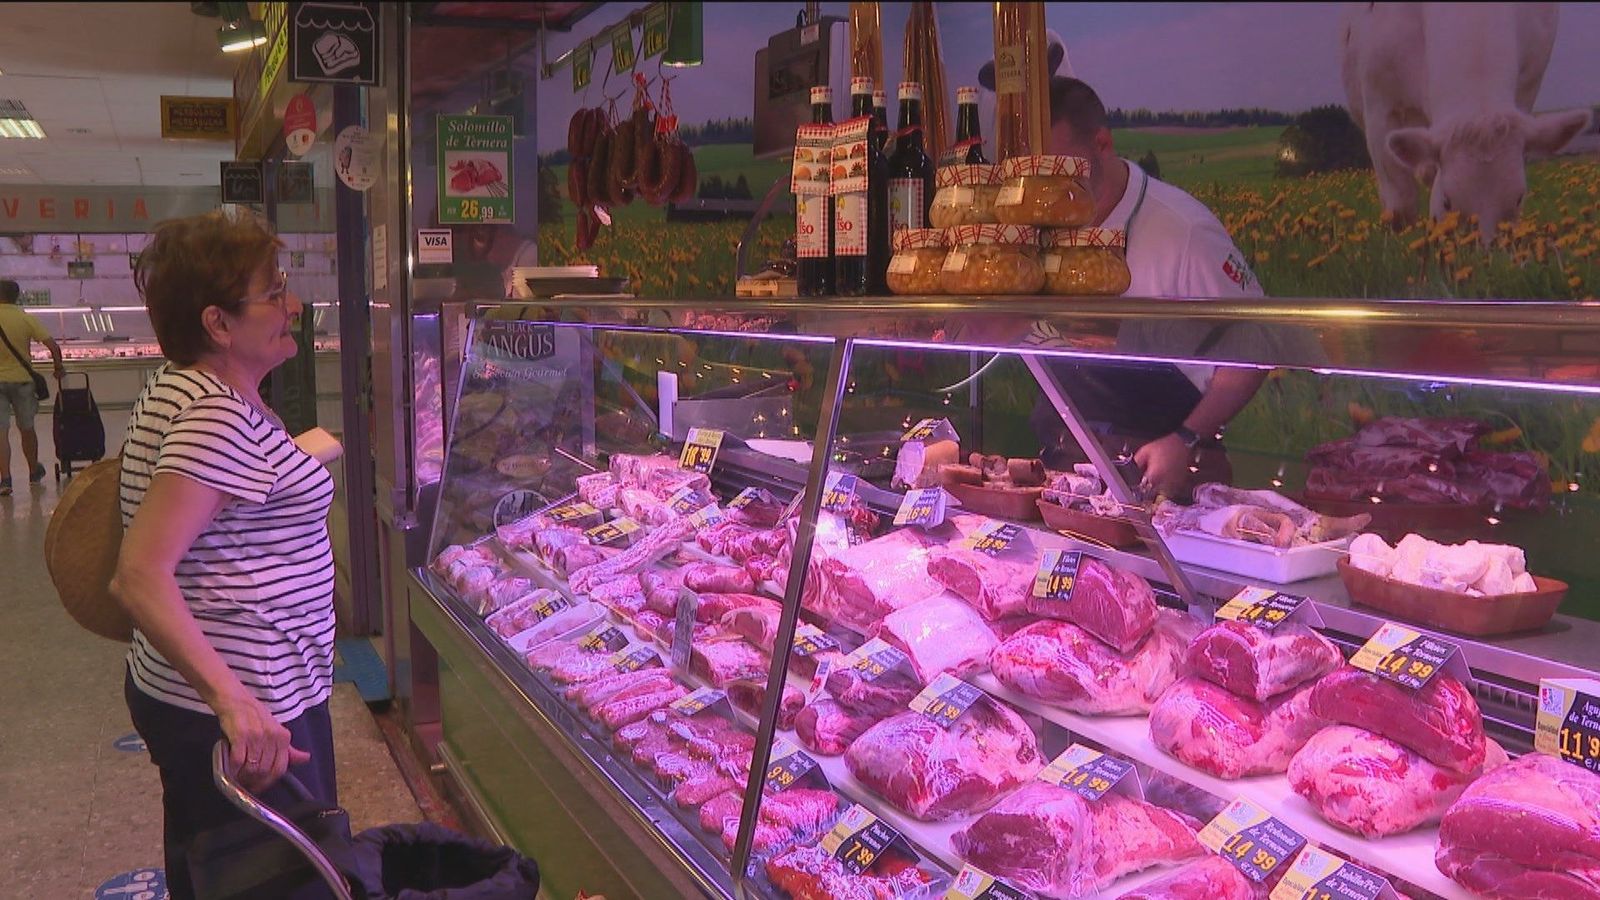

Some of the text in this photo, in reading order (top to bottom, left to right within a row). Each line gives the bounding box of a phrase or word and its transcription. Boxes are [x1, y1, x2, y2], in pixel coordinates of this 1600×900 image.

[448, 120, 506, 133] Solomillo
[446, 135, 508, 148] de Ternera
[425, 237, 447, 246] VISA
[506, 321, 533, 333] BLACK
[487, 333, 553, 359] ANGUS
[1568, 711, 1579, 723] de
[1263, 821, 1297, 847] Redondo
[1248, 827, 1289, 856] de Ternera
[1325, 878, 1338, 889] de
